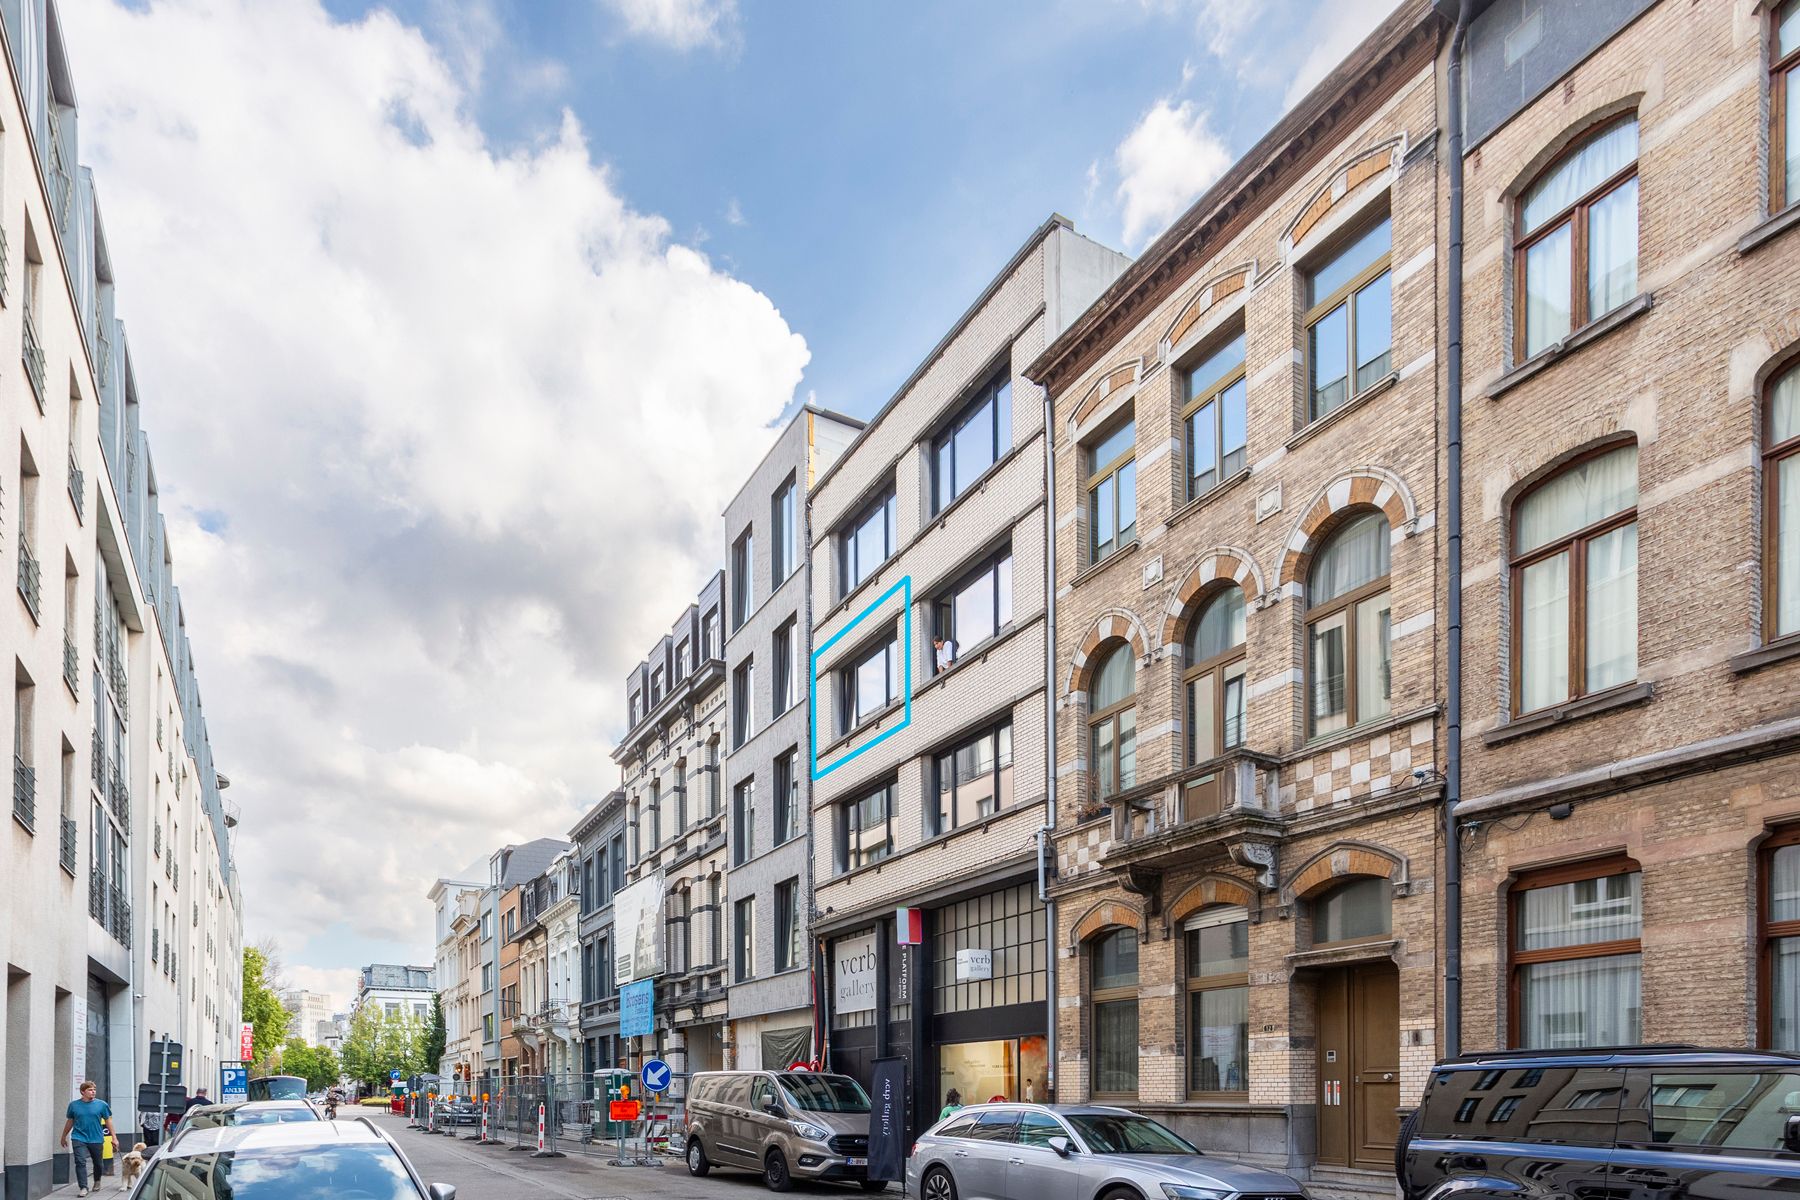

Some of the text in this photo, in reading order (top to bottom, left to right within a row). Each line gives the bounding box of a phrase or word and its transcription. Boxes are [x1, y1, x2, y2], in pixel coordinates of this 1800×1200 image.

[841, 944, 877, 975] vcrb
[970, 954, 991, 965] vcrb
[840, 979, 876, 1002] gallery
